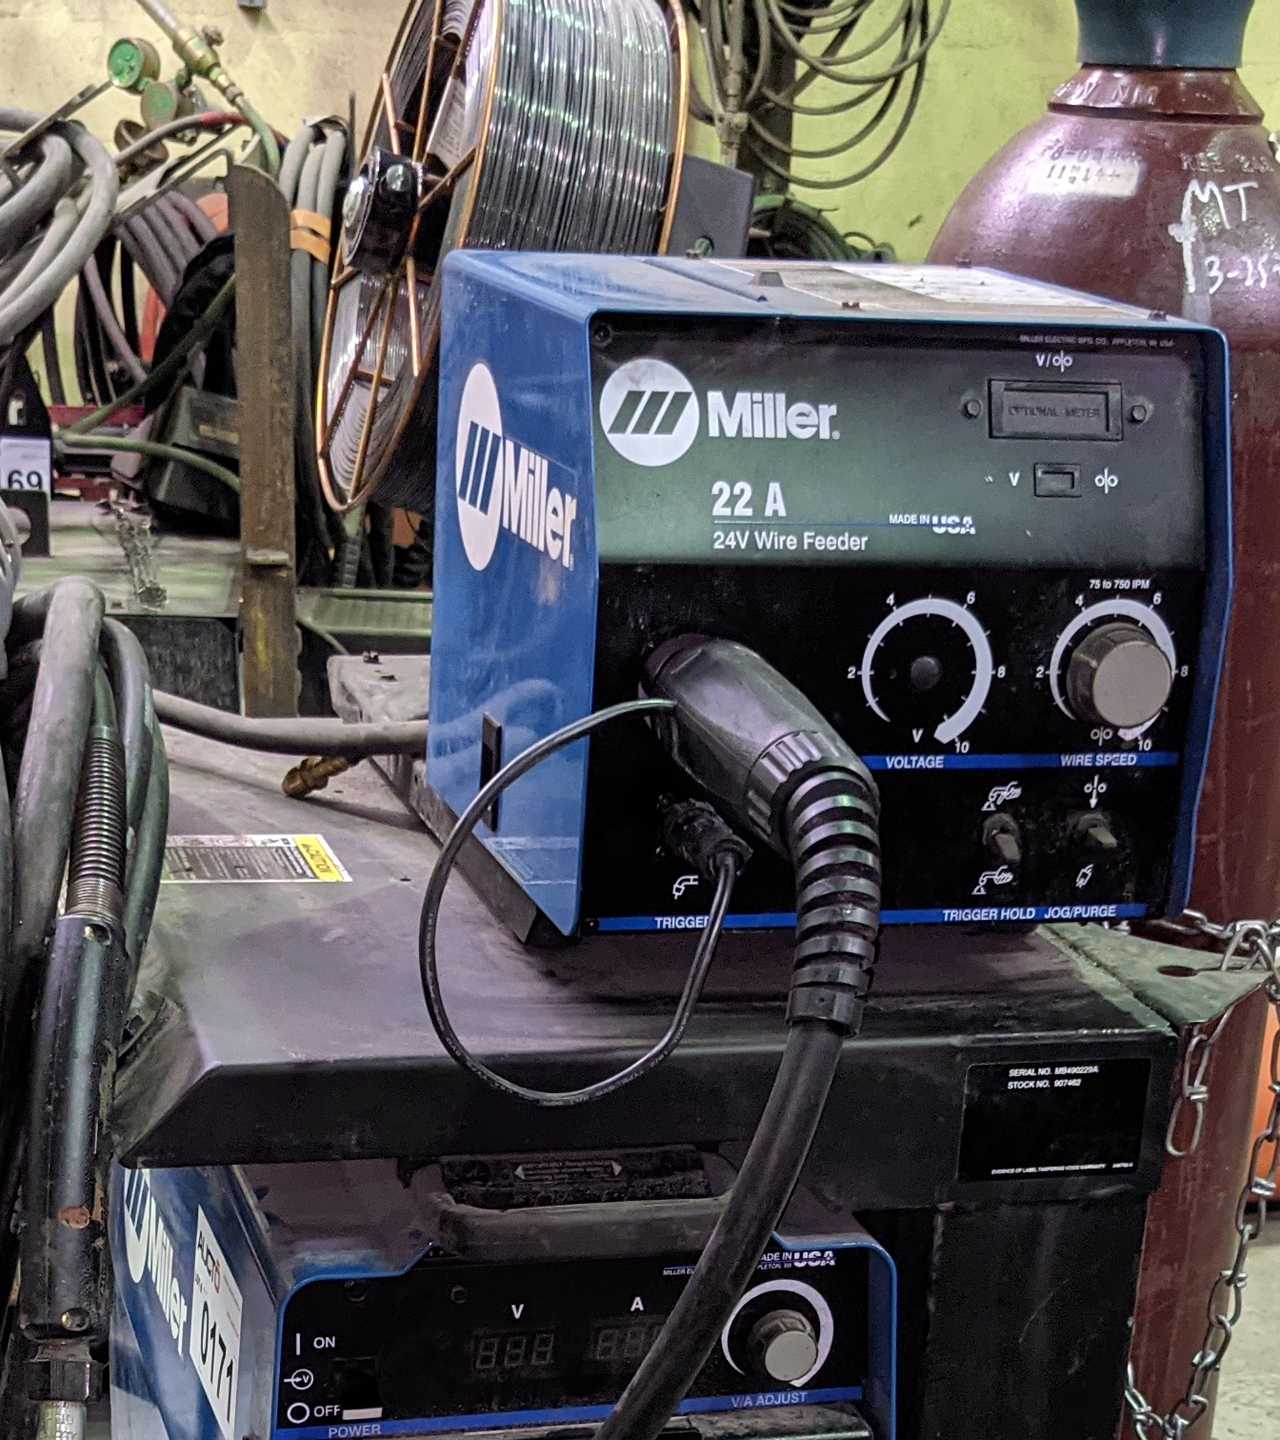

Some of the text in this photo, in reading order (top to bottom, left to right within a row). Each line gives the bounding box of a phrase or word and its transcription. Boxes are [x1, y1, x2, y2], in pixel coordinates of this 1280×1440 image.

[1008, 471, 1020, 487] V
[502, 439, 578, 570] Miller
[711, 480, 787, 518] 22 A
[888, 513, 977, 535] MADE IN USA
[712, 531, 869, 551] 24V Wire Feeder
[885, 591, 976, 606] 4 6
[1074, 593, 1162, 607] 4 6
[847, 666, 1007, 679] 2 8
[1035, 665, 1189, 678] 2 8
[912, 728, 924, 743] V
[955, 741, 970, 753] 10
[1138, 739, 1152, 751] 10
[885, 755, 945, 769] VOLTAGE
[1060, 753, 1138, 767] WIRE SPEED
[943, 907, 1036, 921] TRIGGER HOLD
[1044, 905, 1117, 919] JOG/PURGE
[1008, 1067, 1036, 1077] SERIAL
[1007, 1080, 1035, 1090] STOCK
[761, 1252, 780, 1261] ADE
[782, 1251, 792, 1261] IN
[511, 1296, 645, 1319] V A
[313, 1335, 336, 1350] ON
[201, 1300, 234, 1424] 0171
[731, 1391, 808, 1409] V/A ADJUST
[313, 1404, 341, 1418] OFF
[328, 1423, 382, 1439] POWER
